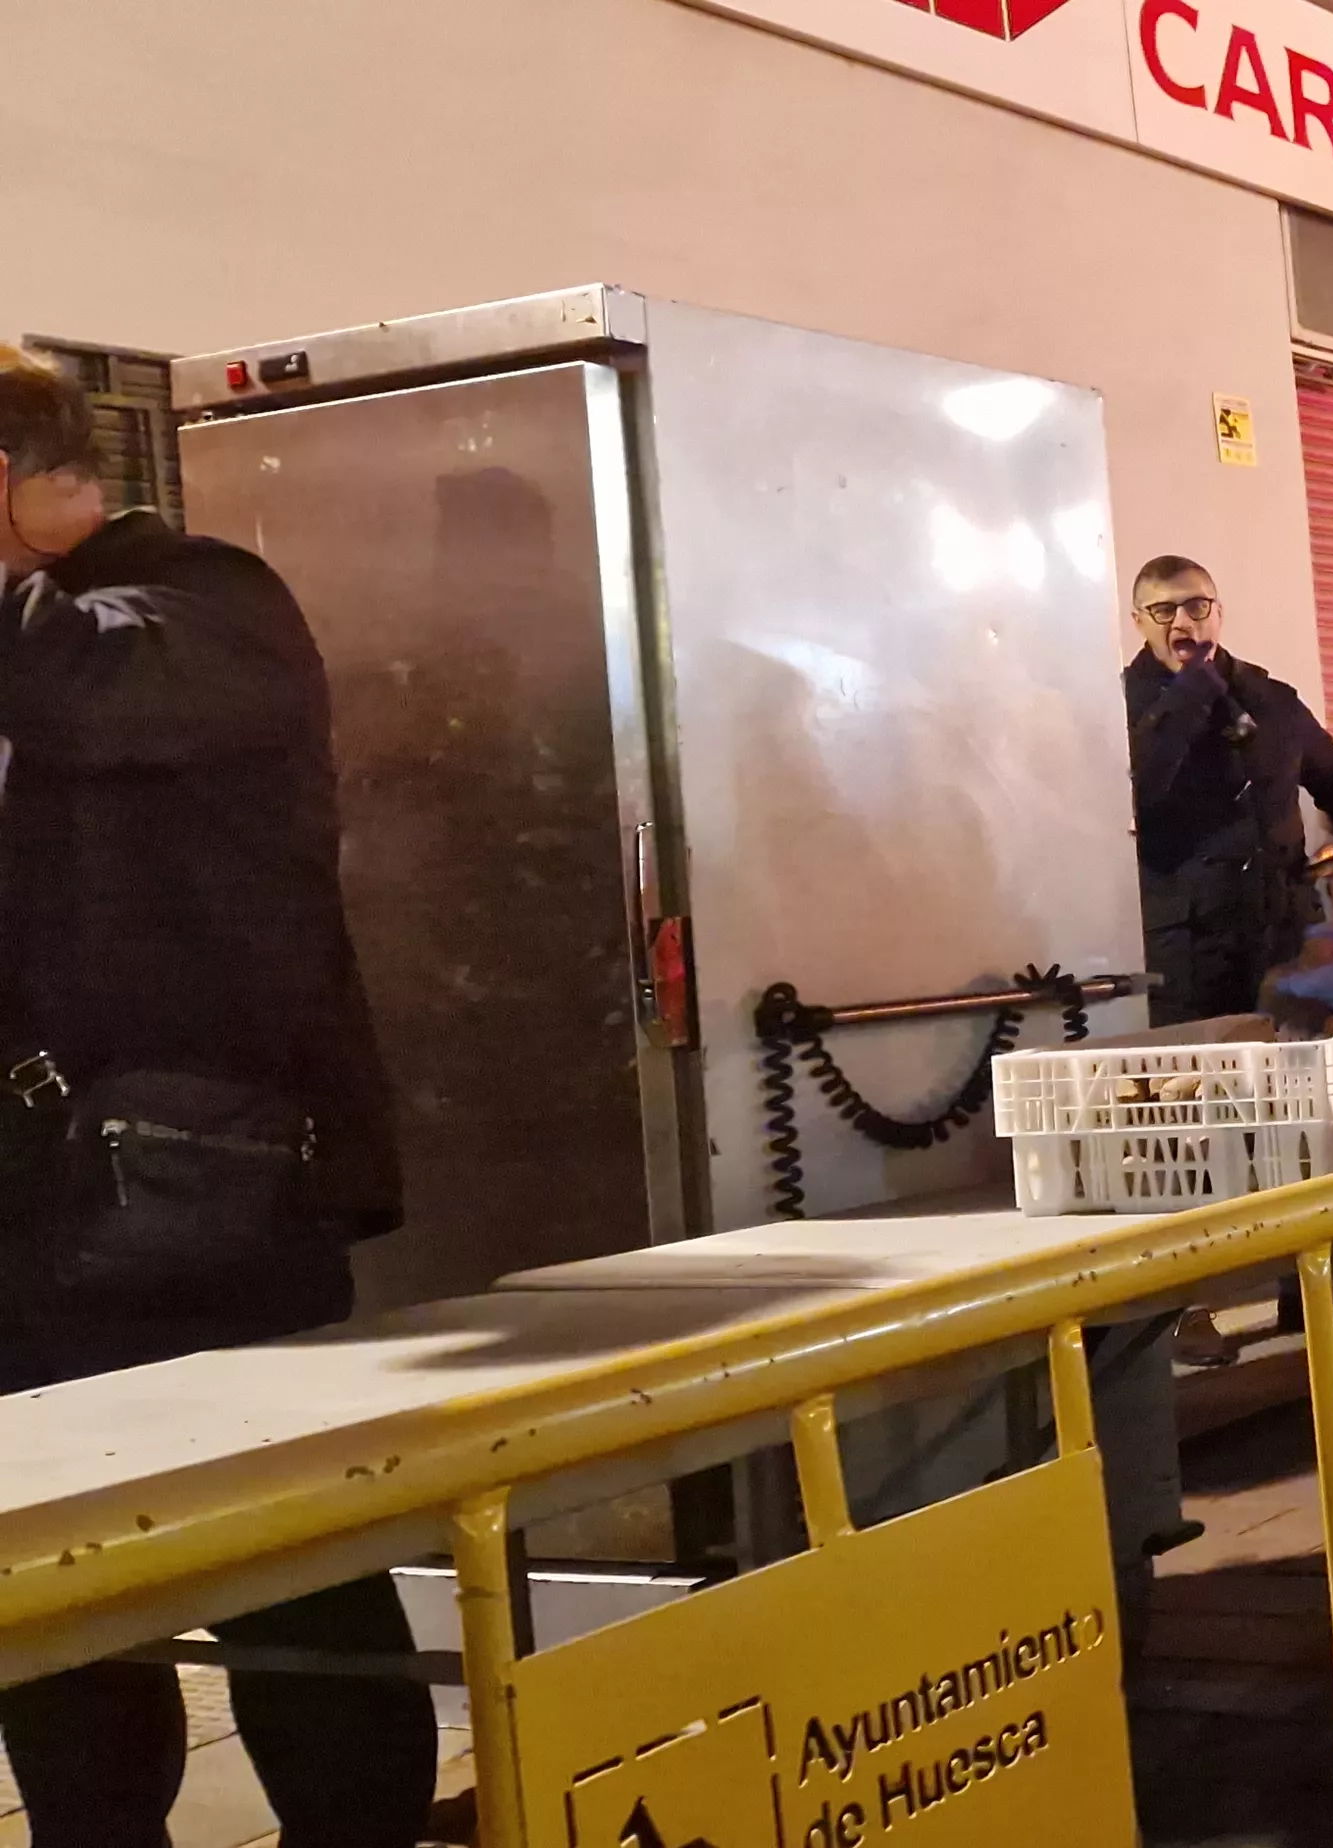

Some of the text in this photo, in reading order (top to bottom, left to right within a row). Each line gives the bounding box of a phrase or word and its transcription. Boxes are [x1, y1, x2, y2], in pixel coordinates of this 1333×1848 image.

[799, 1608, 1104, 1788] Ayuntamiento
[802, 1709, 1049, 1848] de Huesca
